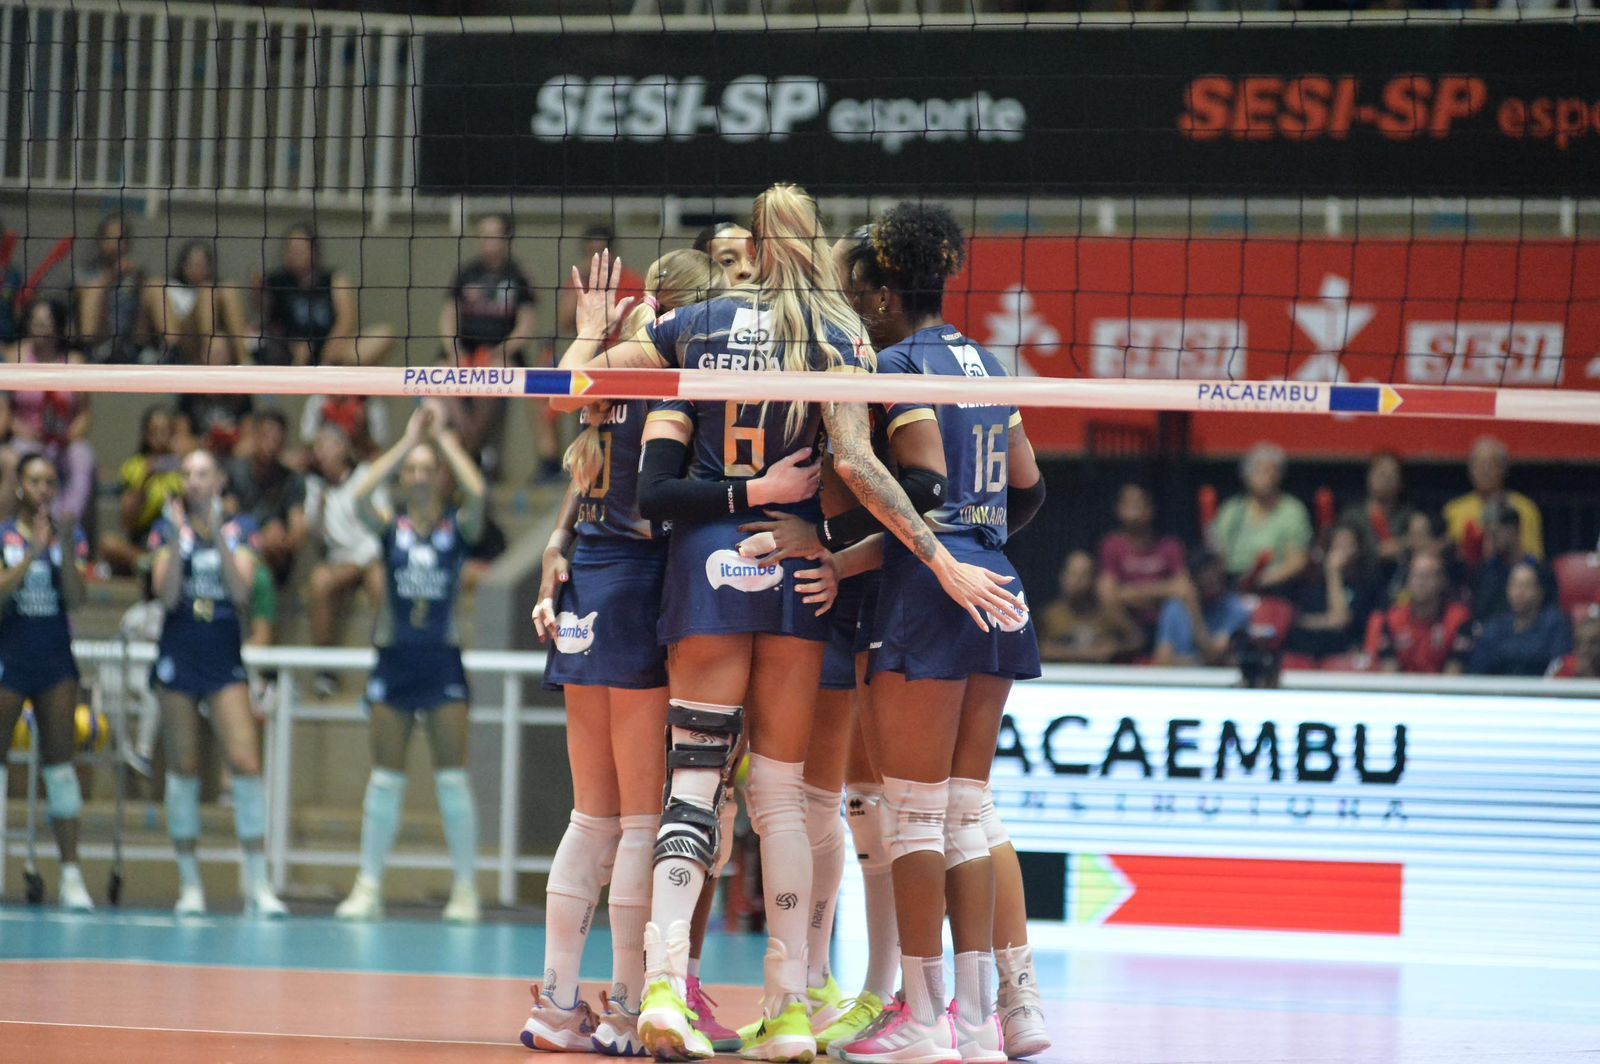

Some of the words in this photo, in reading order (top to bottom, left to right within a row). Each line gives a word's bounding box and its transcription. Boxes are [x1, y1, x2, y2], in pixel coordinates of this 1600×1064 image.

[531, 74, 826, 142] SESI-SP
[828, 91, 1027, 153] esporte
[1178, 73, 1488, 141] SESI-SP
[403, 368, 514, 385] PACAEMBU
[698, 352, 782, 371] GERDA
[402, 387, 514, 395] CONSTRUTORA
[1198, 383, 1318, 401] PACAEMBU
[724, 399, 765, 477] 6
[972, 423, 1007, 493] 16
[556, 624, 589, 639] ambé
[994, 713, 1407, 785] ACAEMBU
